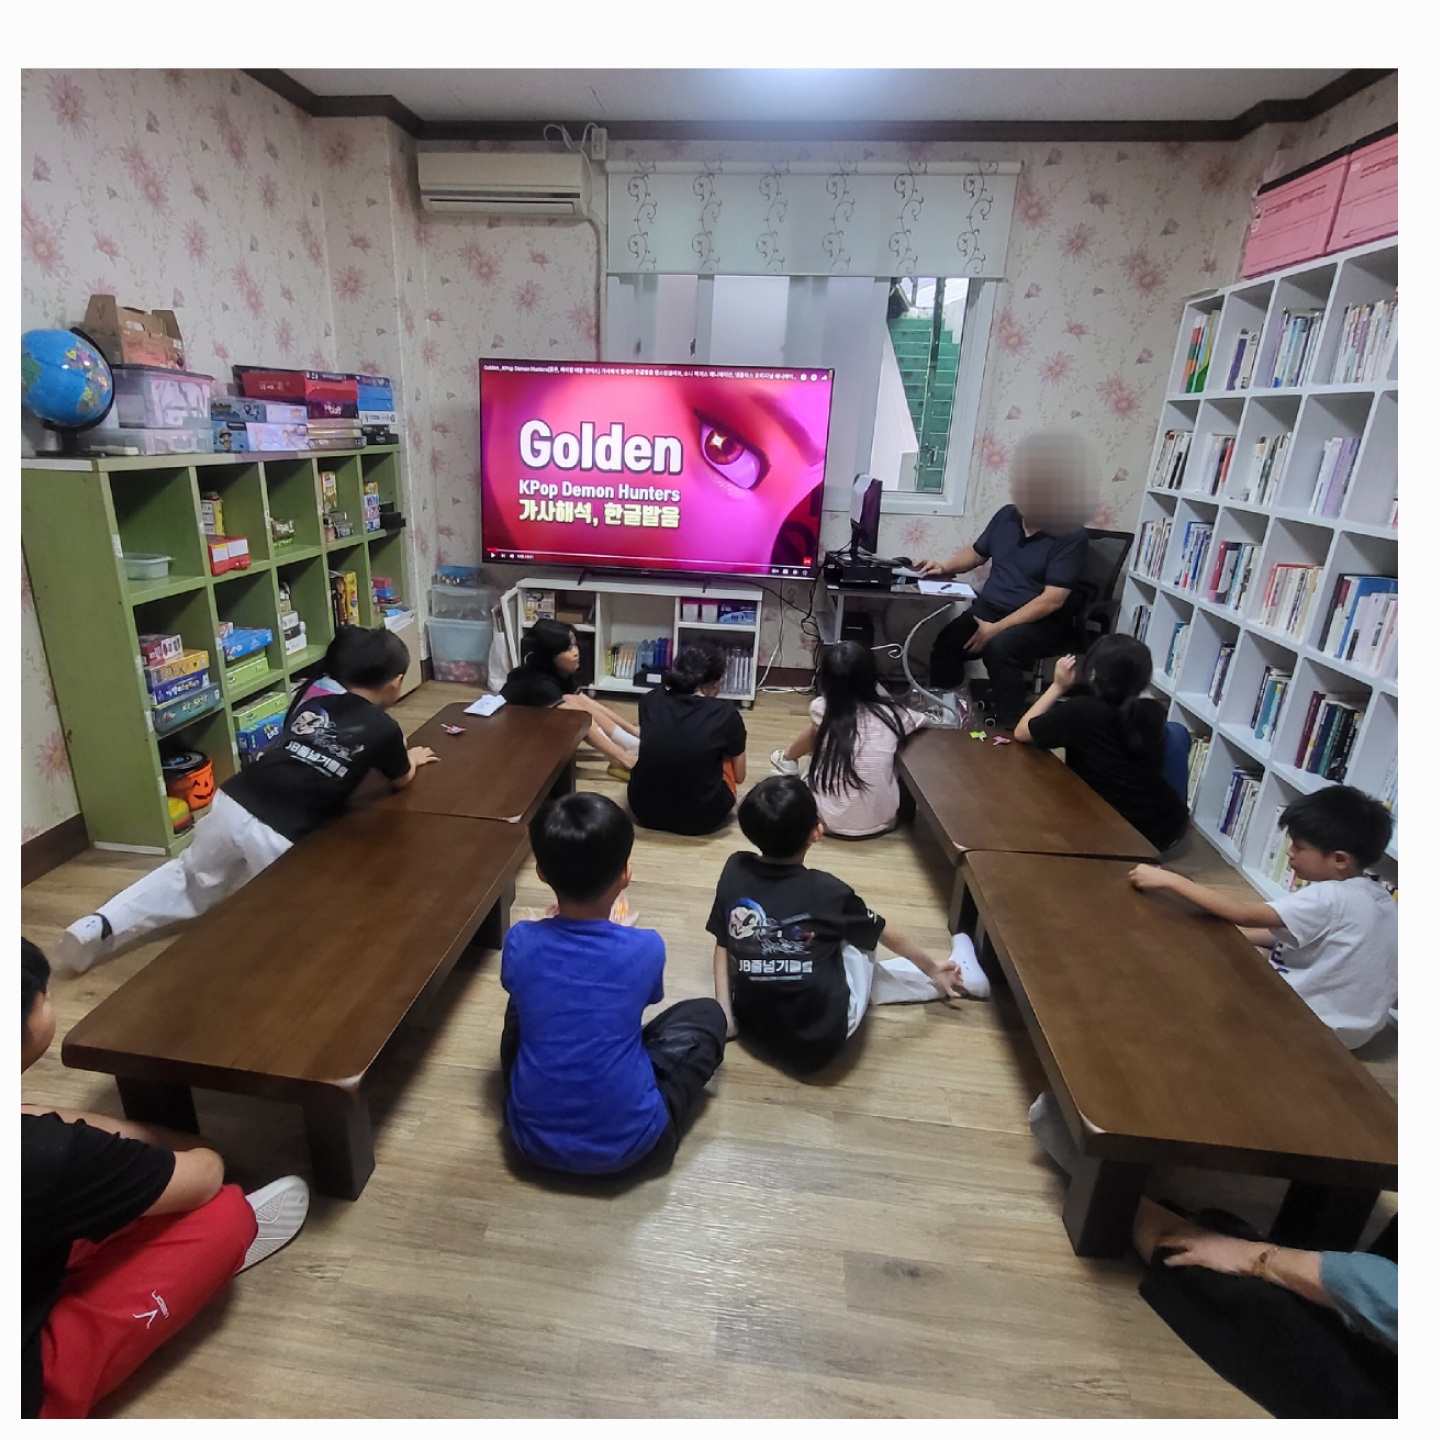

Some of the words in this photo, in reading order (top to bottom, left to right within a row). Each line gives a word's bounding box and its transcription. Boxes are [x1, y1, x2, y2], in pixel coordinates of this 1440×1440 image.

[519, 419, 683, 475] Golden
[519, 479, 558, 499] KPop
[562, 481, 614, 499] Demon
[618, 483, 681, 501] Hunters
[519, 499, 599, 527] 가사해석,
[603, 502, 680, 528] 한글발음
